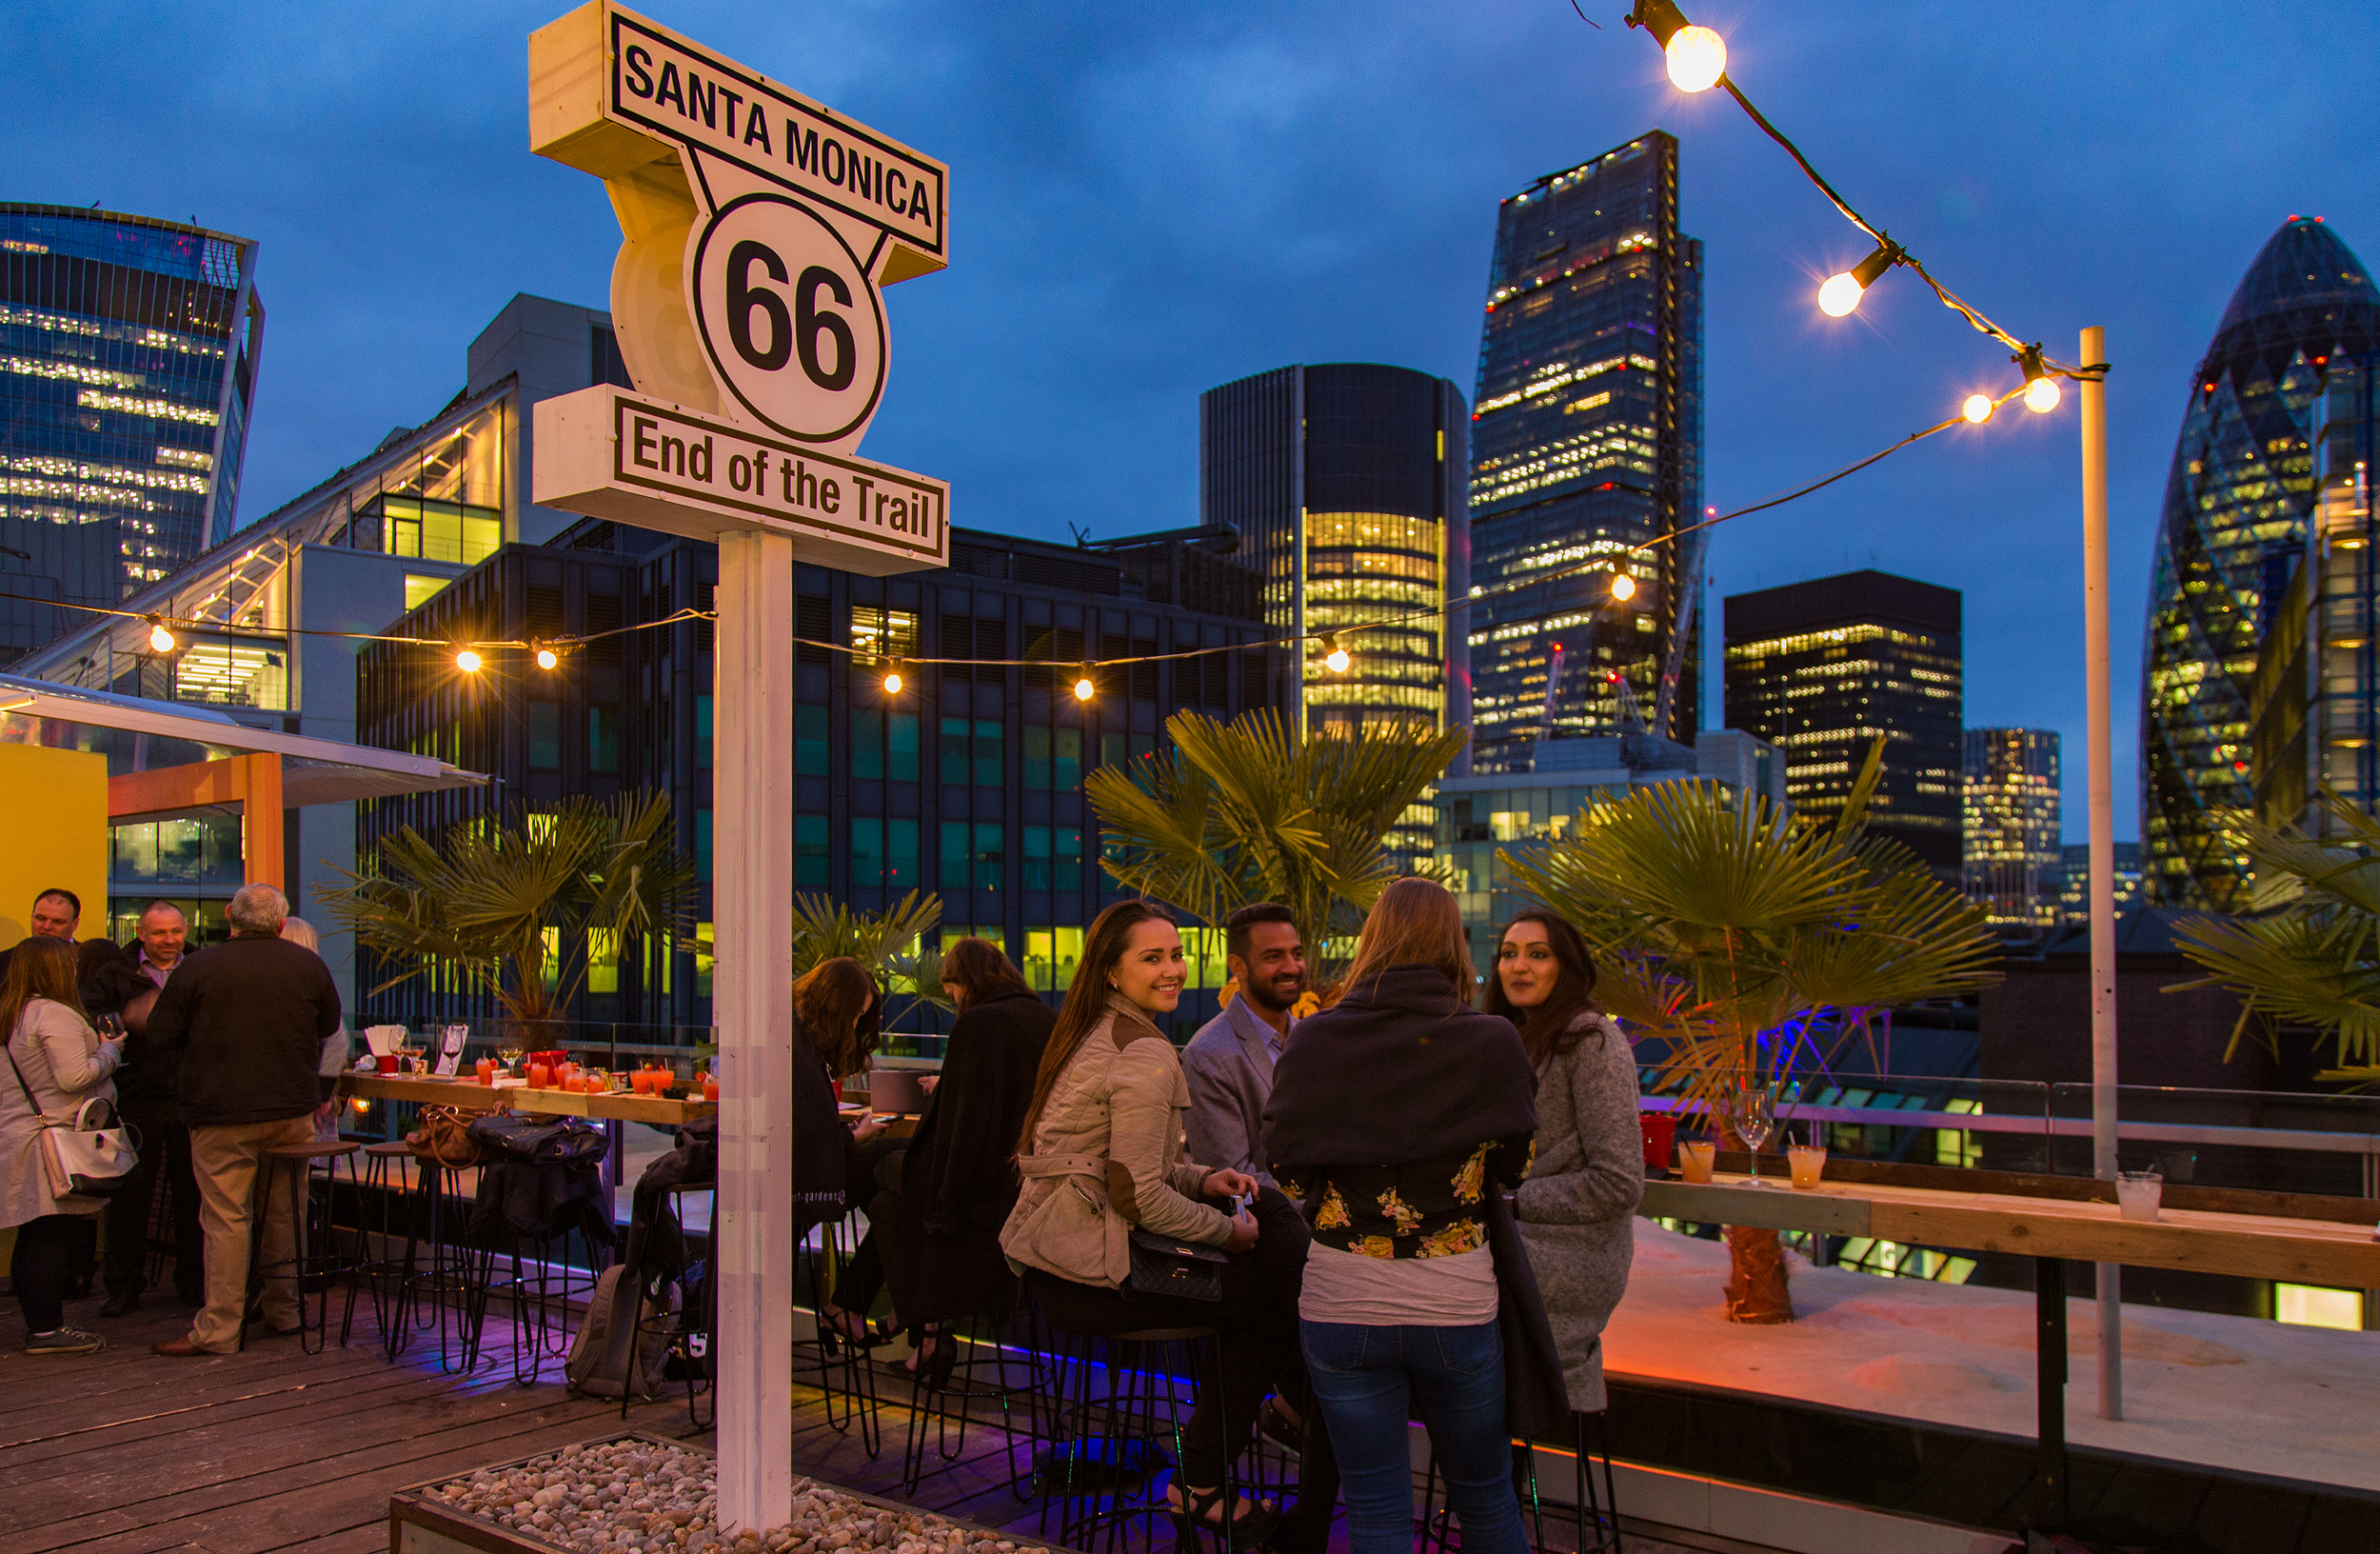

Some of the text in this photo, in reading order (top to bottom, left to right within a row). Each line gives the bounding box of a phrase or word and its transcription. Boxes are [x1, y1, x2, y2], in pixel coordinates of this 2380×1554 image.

[625, 44, 933, 229] SANTA MONICA
[725, 239, 857, 392] 66
[633, 415, 929, 538] End of the Trail
